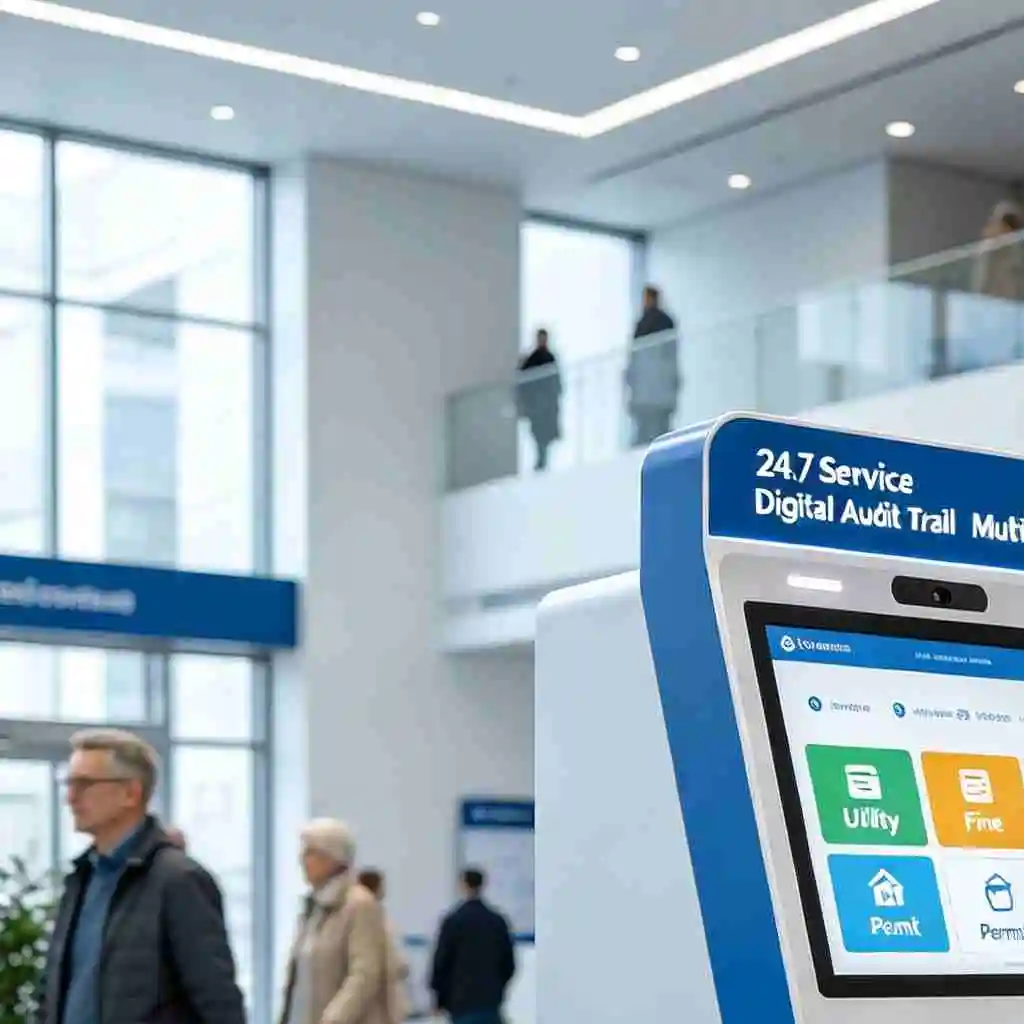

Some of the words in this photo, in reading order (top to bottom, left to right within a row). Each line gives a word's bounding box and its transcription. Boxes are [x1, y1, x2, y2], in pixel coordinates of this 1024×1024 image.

[819, 455, 914, 495] Service
[755, 487, 834, 524] Digital
[839, 498, 902, 529] Audit
